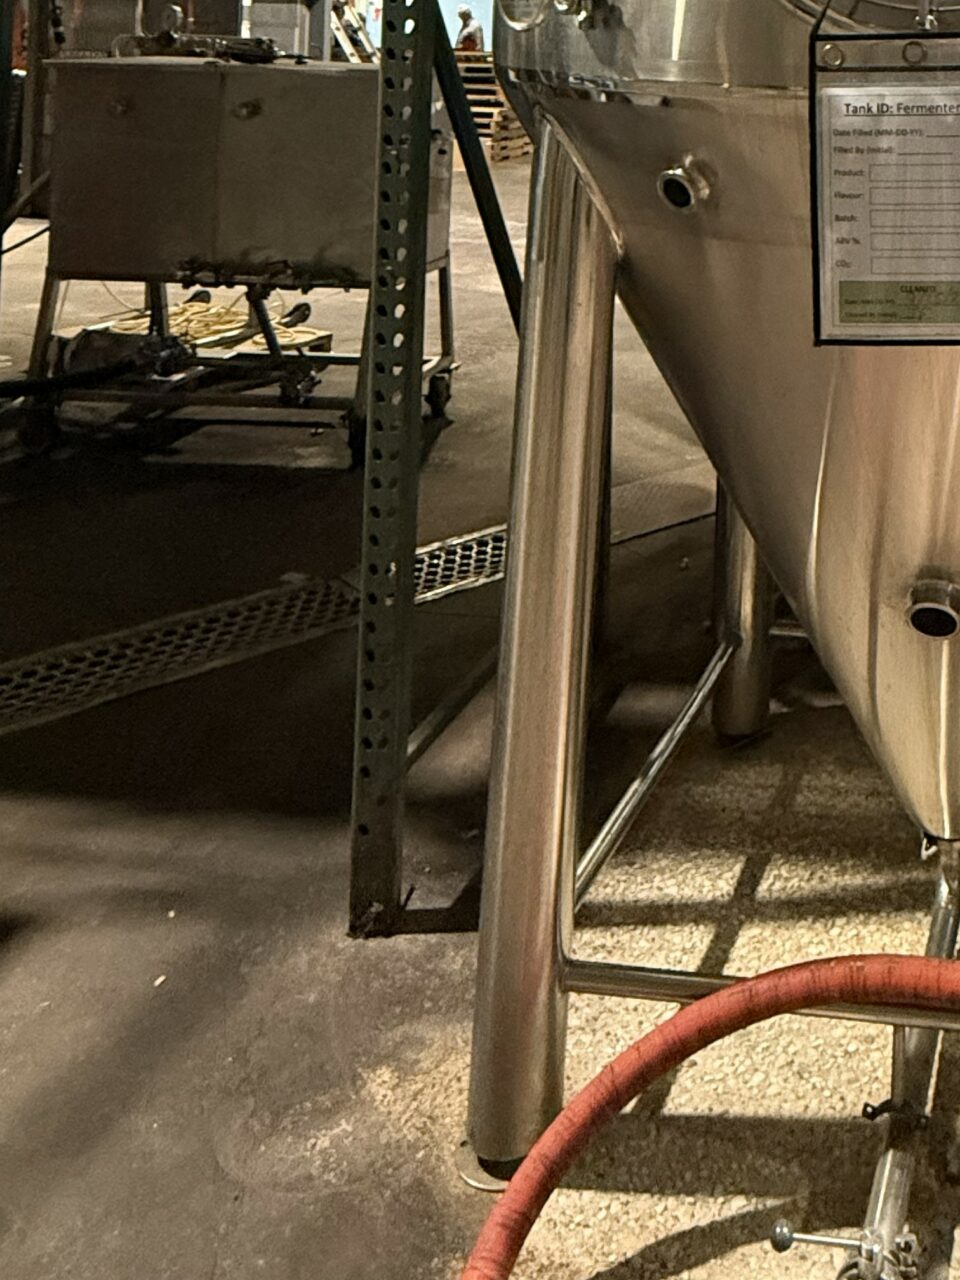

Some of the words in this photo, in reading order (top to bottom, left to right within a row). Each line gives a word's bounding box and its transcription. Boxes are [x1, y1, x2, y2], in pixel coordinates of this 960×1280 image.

[844, 103, 875, 114] Tank
[877, 103, 894, 114] ID:
[897, 102, 960, 114] Fermenter
